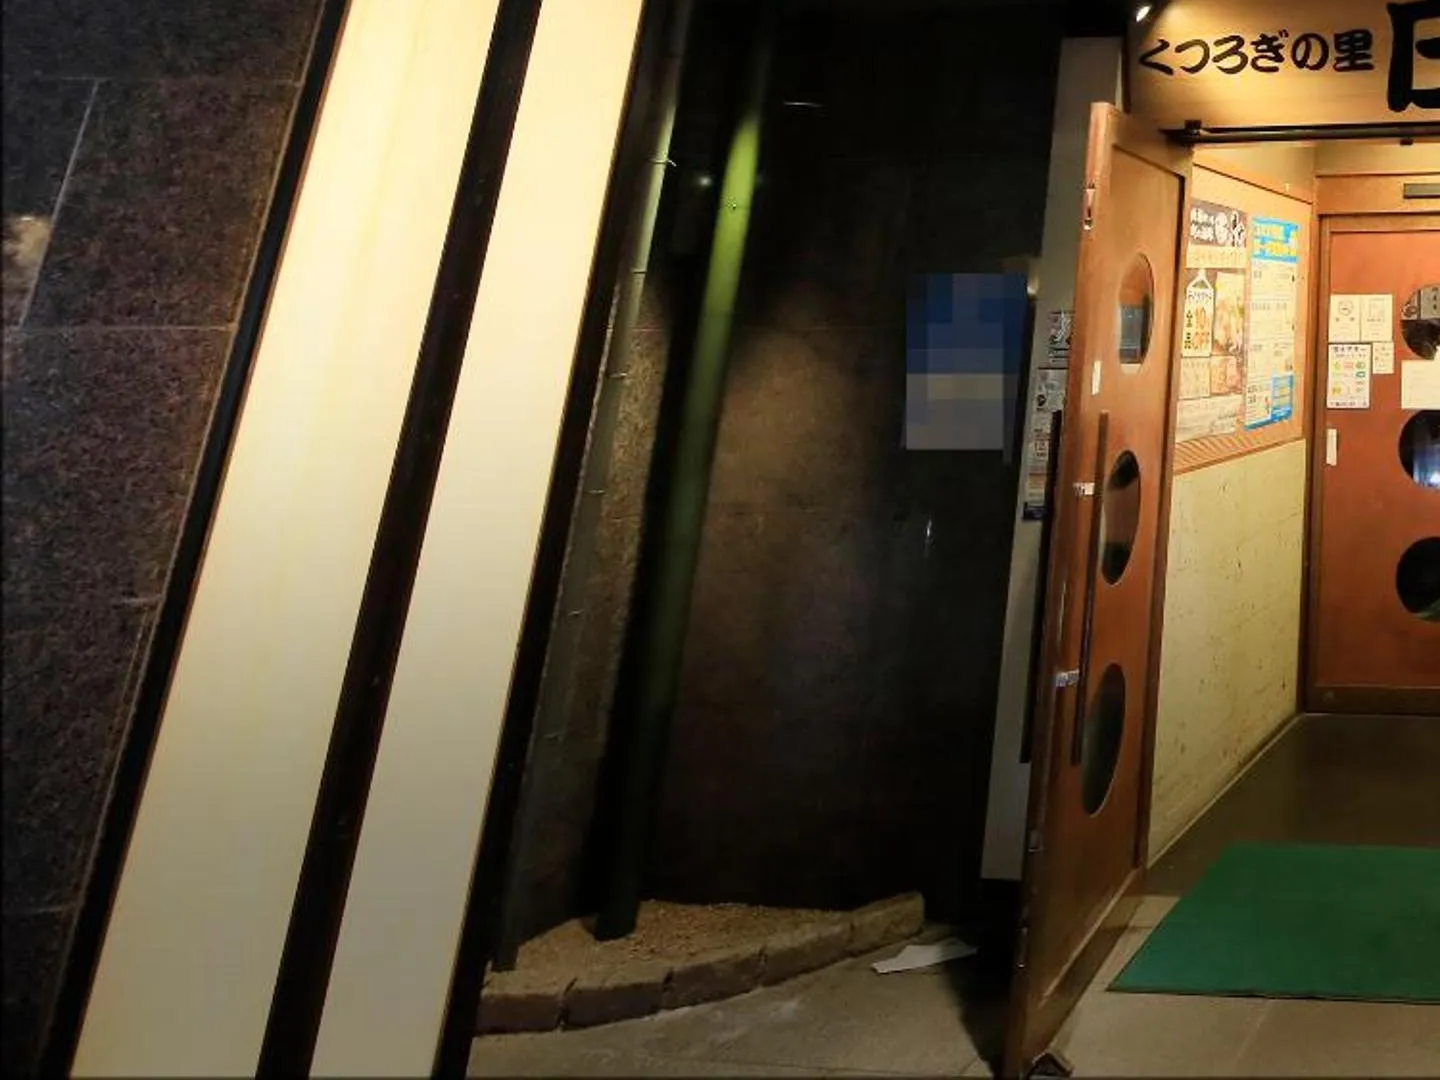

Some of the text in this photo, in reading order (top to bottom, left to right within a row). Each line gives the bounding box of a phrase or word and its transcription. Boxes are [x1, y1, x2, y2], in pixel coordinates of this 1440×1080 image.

[1138, 29, 1375, 75] くつろぎの里
